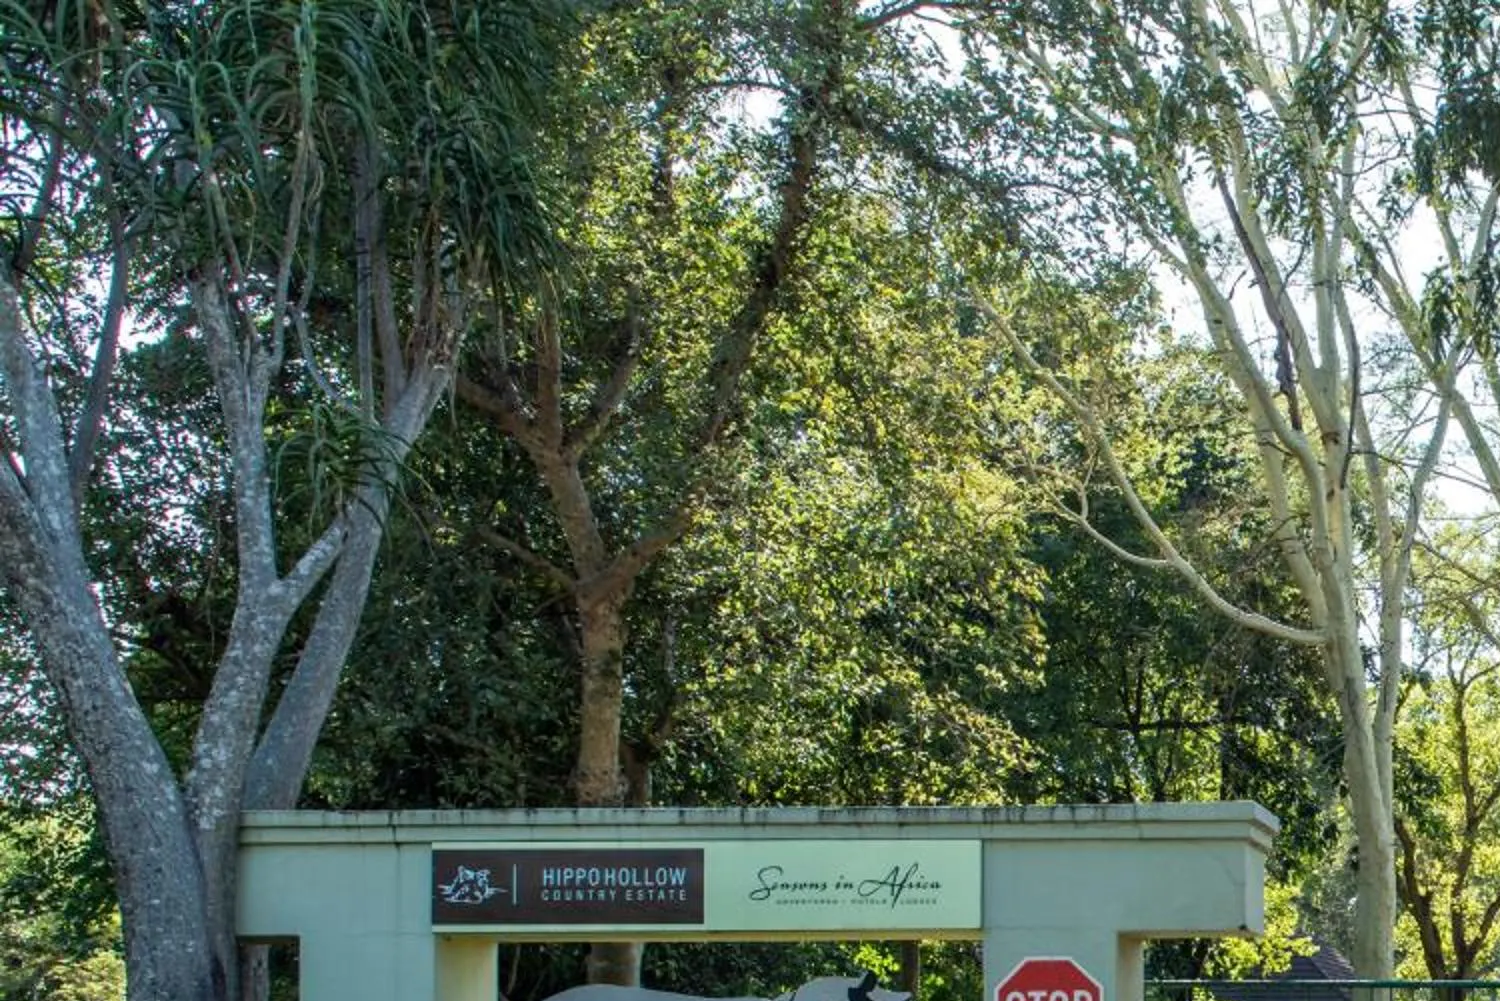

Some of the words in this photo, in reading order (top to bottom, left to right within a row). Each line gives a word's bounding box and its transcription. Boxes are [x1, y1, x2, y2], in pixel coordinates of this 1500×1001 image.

[541, 889, 618, 901] COUNTRY
[624, 889, 688, 901] ESTATE
[835, 874, 854, 890] in
[857, 862, 942, 909] Africa
